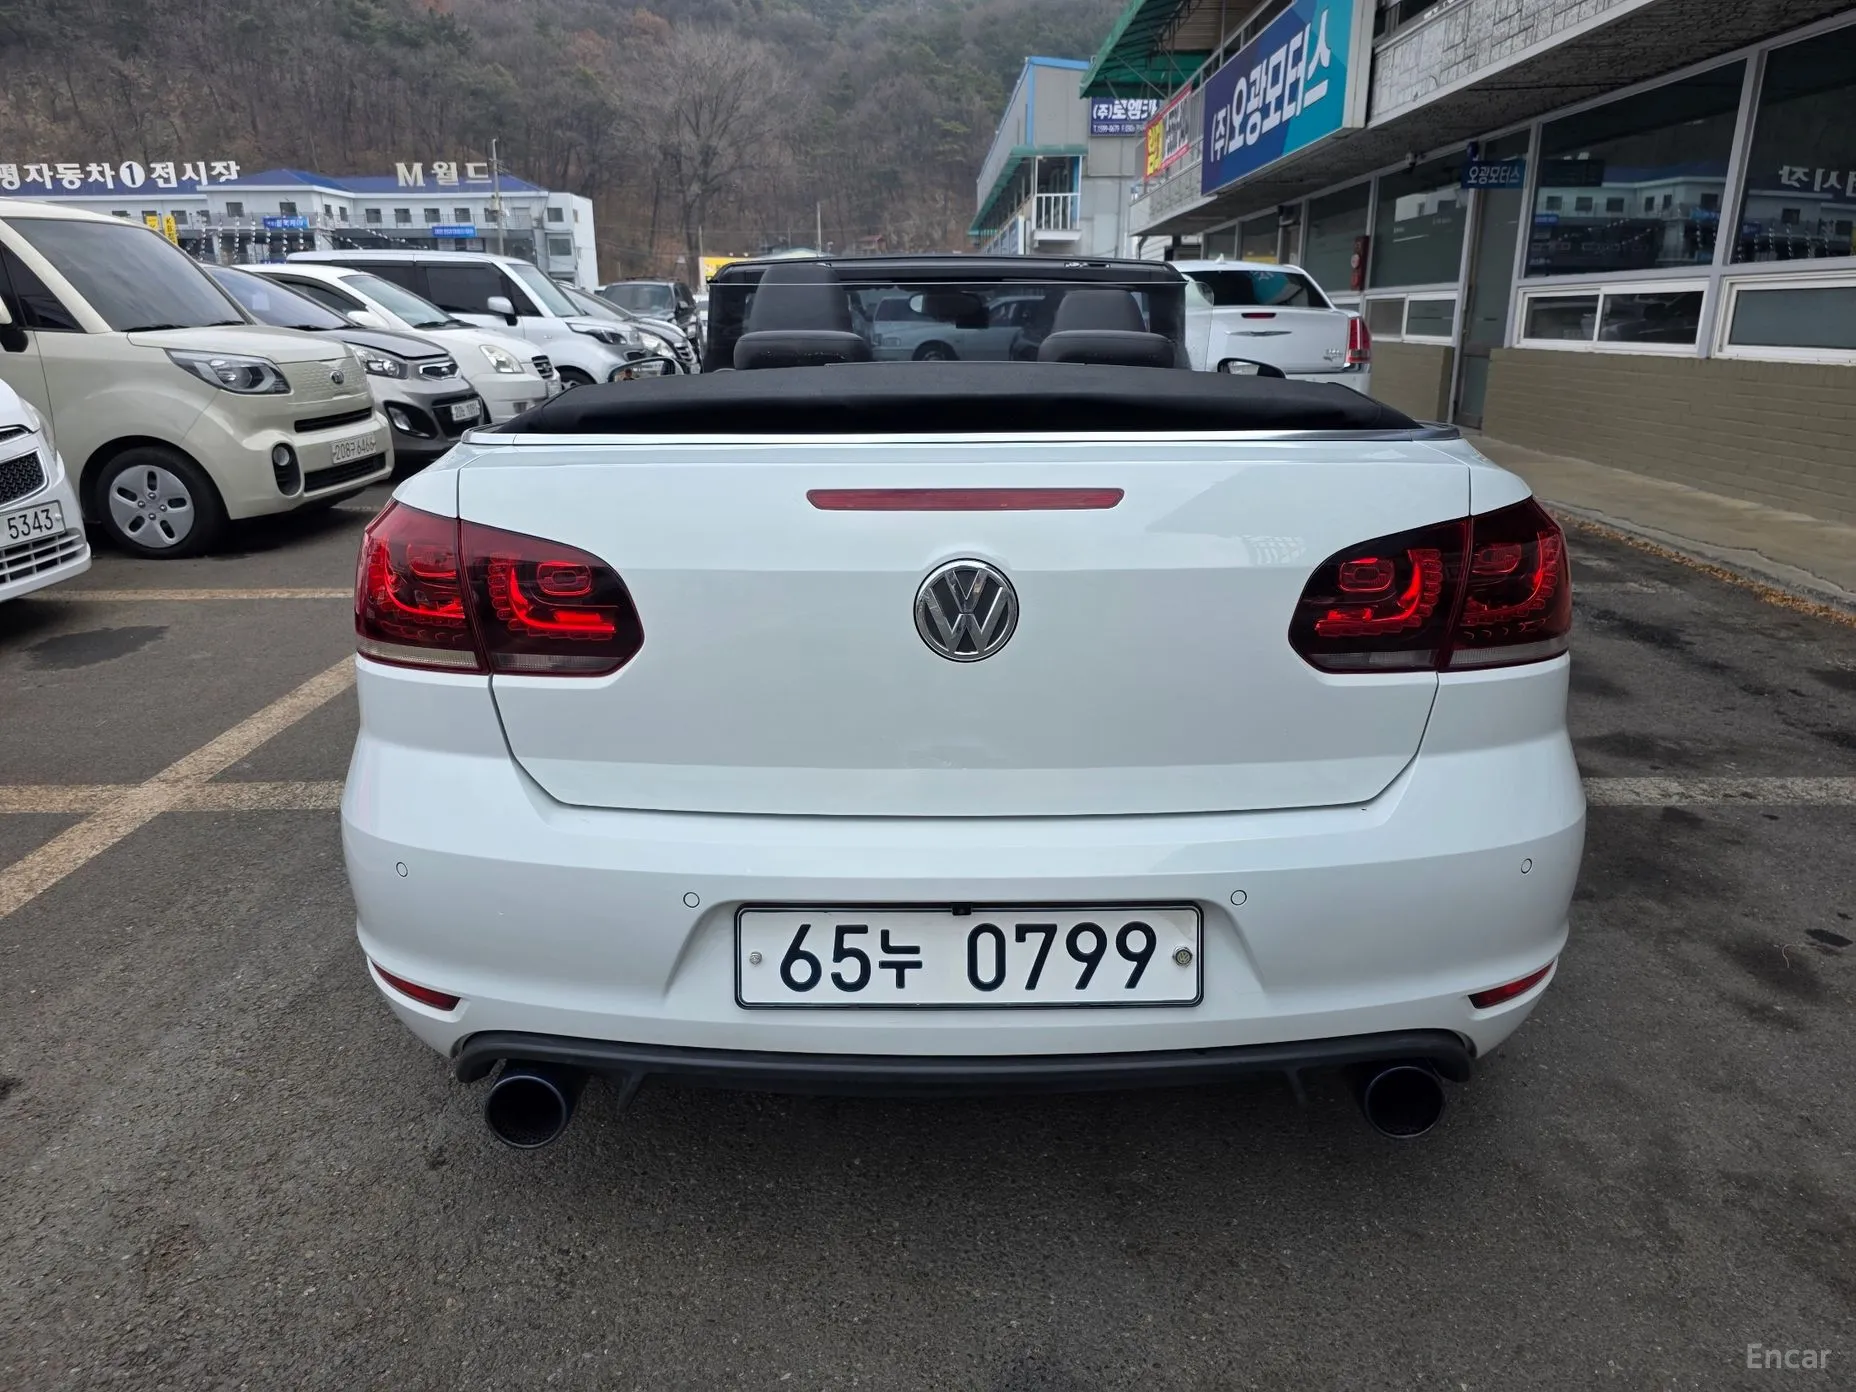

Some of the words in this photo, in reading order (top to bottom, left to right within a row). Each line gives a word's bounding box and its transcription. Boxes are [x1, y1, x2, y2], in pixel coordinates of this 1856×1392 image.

[1211, 9, 1331, 163] (주)오광모터스
[1467, 166, 1520, 184] 오광모터스
[7, 508, 54, 539] 5343
[779, 923, 923, 993] 65누
[966, 921, 1157, 992] 0799
